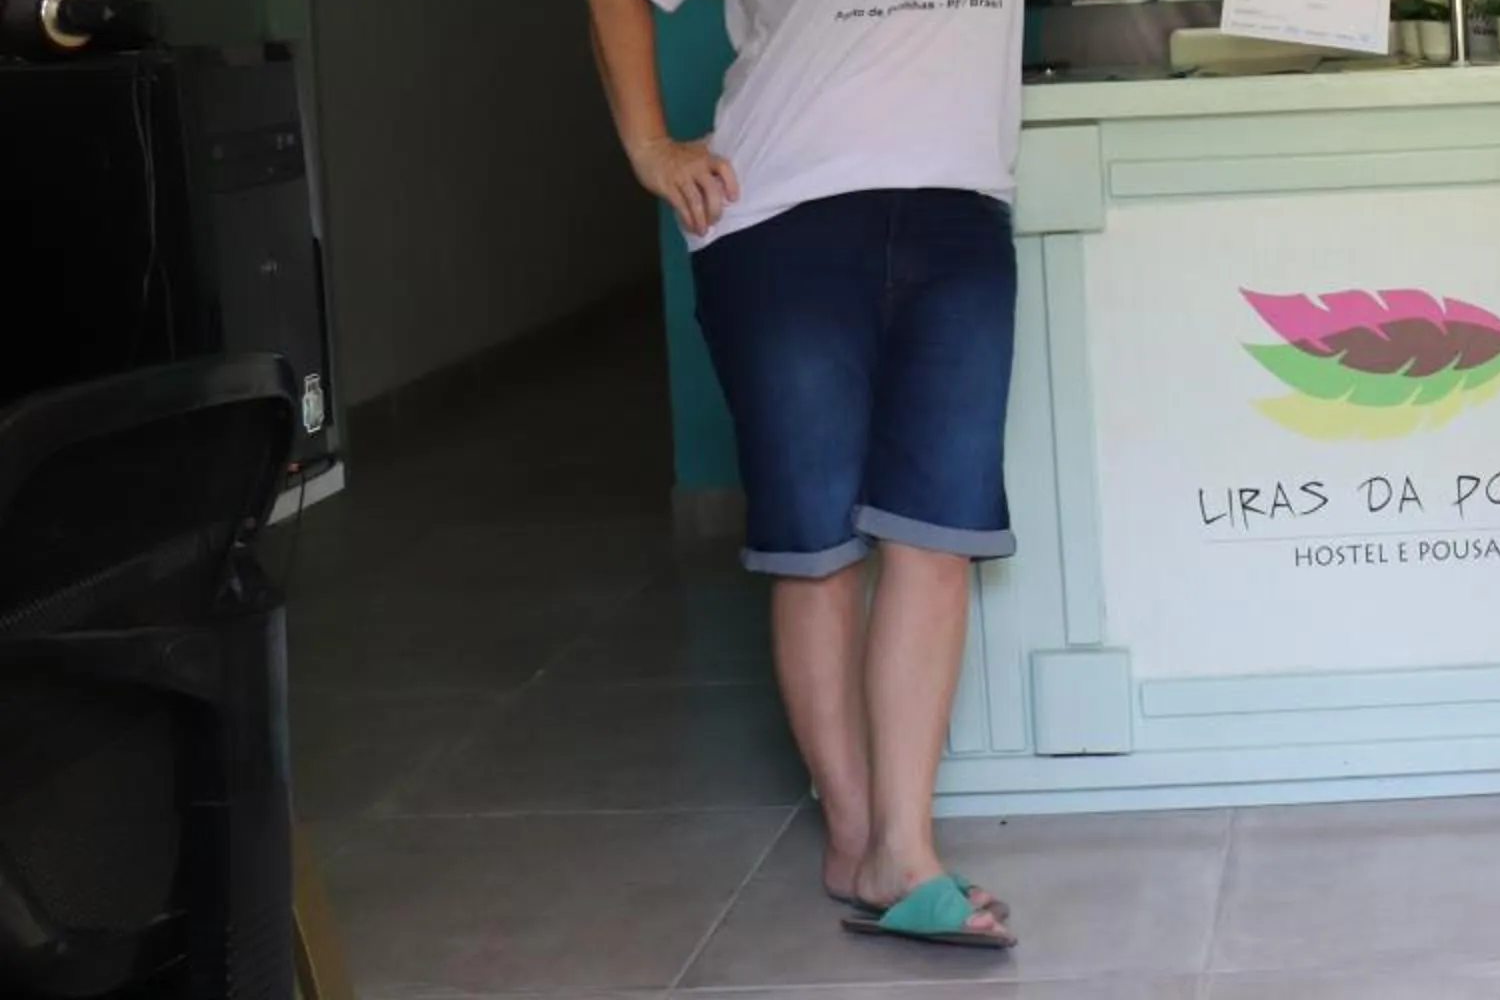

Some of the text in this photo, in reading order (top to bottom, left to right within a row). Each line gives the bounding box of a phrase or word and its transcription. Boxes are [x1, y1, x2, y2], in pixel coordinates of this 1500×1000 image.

[1199, 481, 1329, 529] LIRAS
[1357, 475, 1424, 513] DA
[1295, 543, 1388, 567] HOSTEL
[1399, 542, 1409, 563] E
